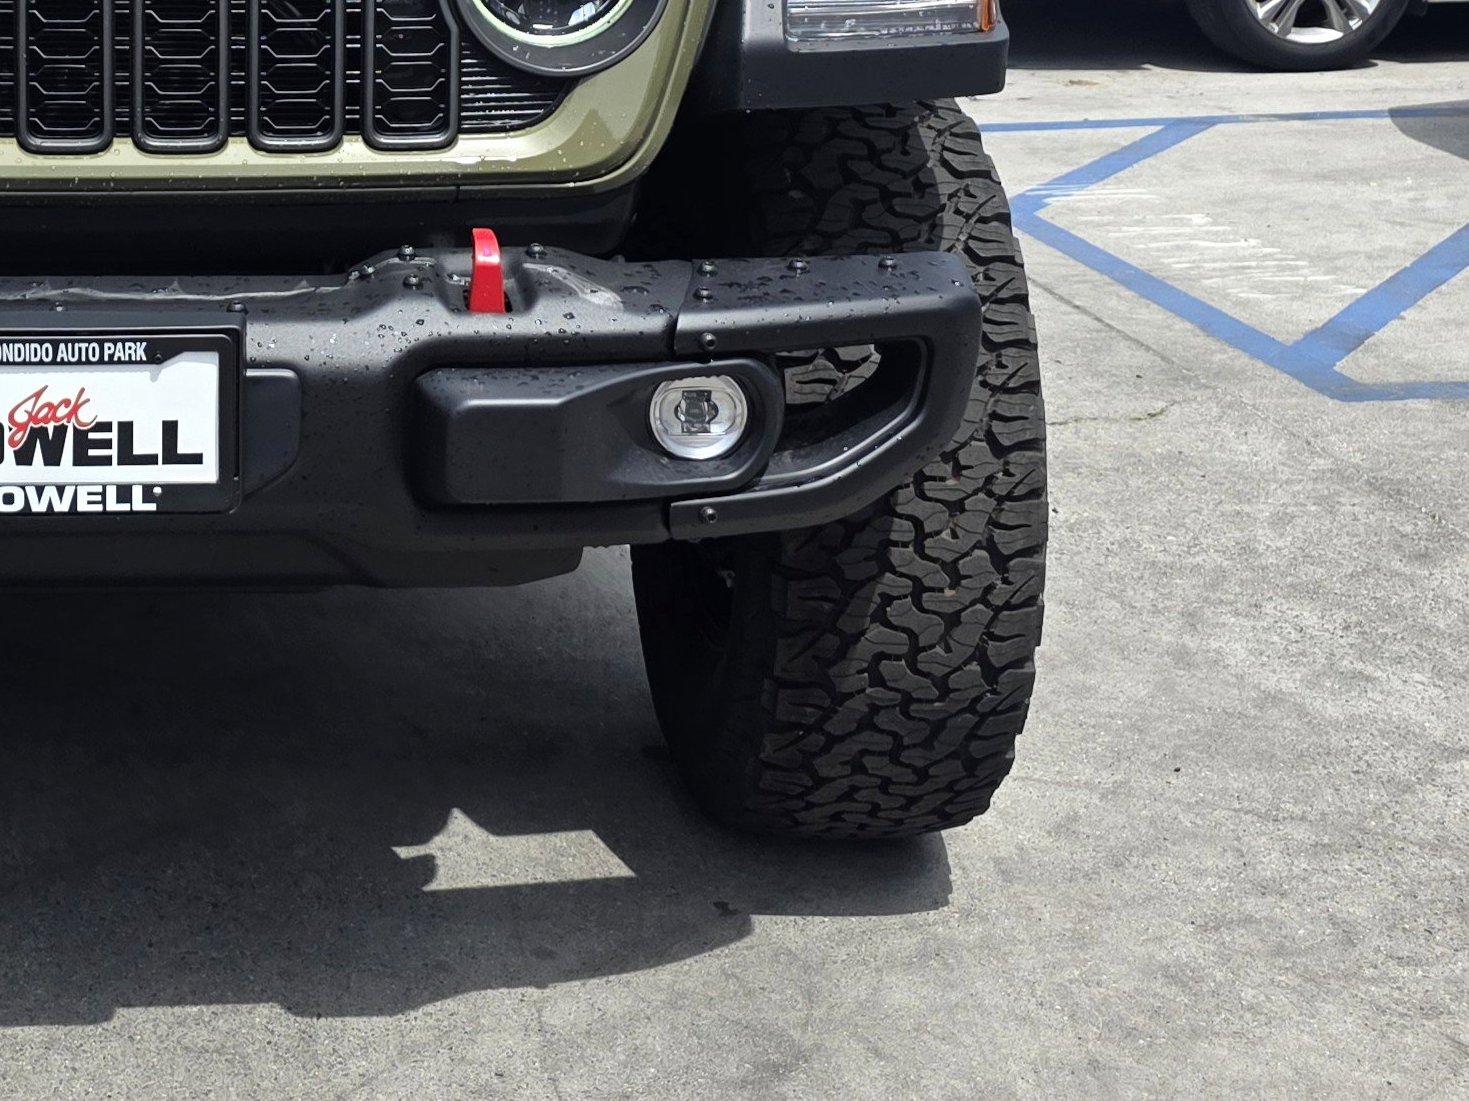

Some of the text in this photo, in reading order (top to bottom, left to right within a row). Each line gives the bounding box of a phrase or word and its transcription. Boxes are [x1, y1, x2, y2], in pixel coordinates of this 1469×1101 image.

[57, 341, 100, 362] AUTO
[103, 341, 147, 361] PARK
[7, 384, 98, 449] Jack
